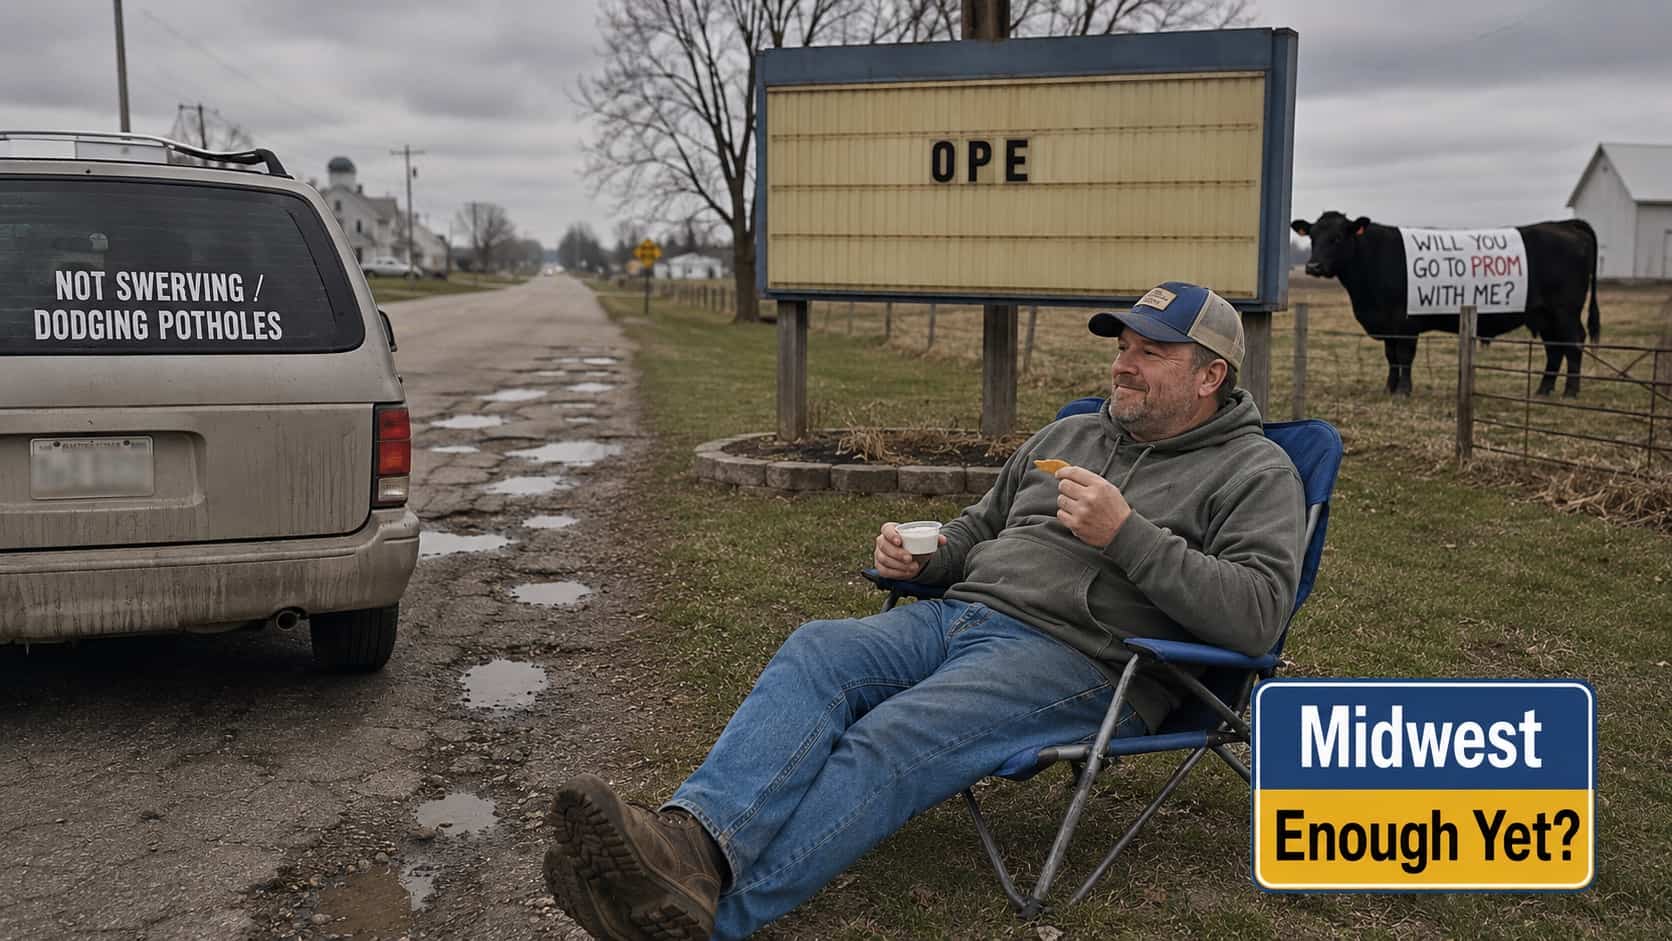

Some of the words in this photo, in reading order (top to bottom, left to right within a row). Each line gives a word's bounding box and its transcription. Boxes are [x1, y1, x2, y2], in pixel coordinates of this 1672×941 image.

[931, 139, 1029, 184] OPE
[1412, 235, 1464, 251] WILL
[1471, 234, 1508, 250] YOU
[1413, 257, 1440, 279] GO
[1444, 257, 1466, 278] TO
[1471, 255, 1523, 277] PROM
[55, 270, 105, 302] NOT
[116, 270, 245, 303] SWERVING
[252, 273, 265, 303] /
[1417, 284, 1465, 307] WITH
[1472, 280, 1516, 306] ME?
[33, 309, 149, 341] DODGING
[158, 310, 283, 341] POTHOLES
